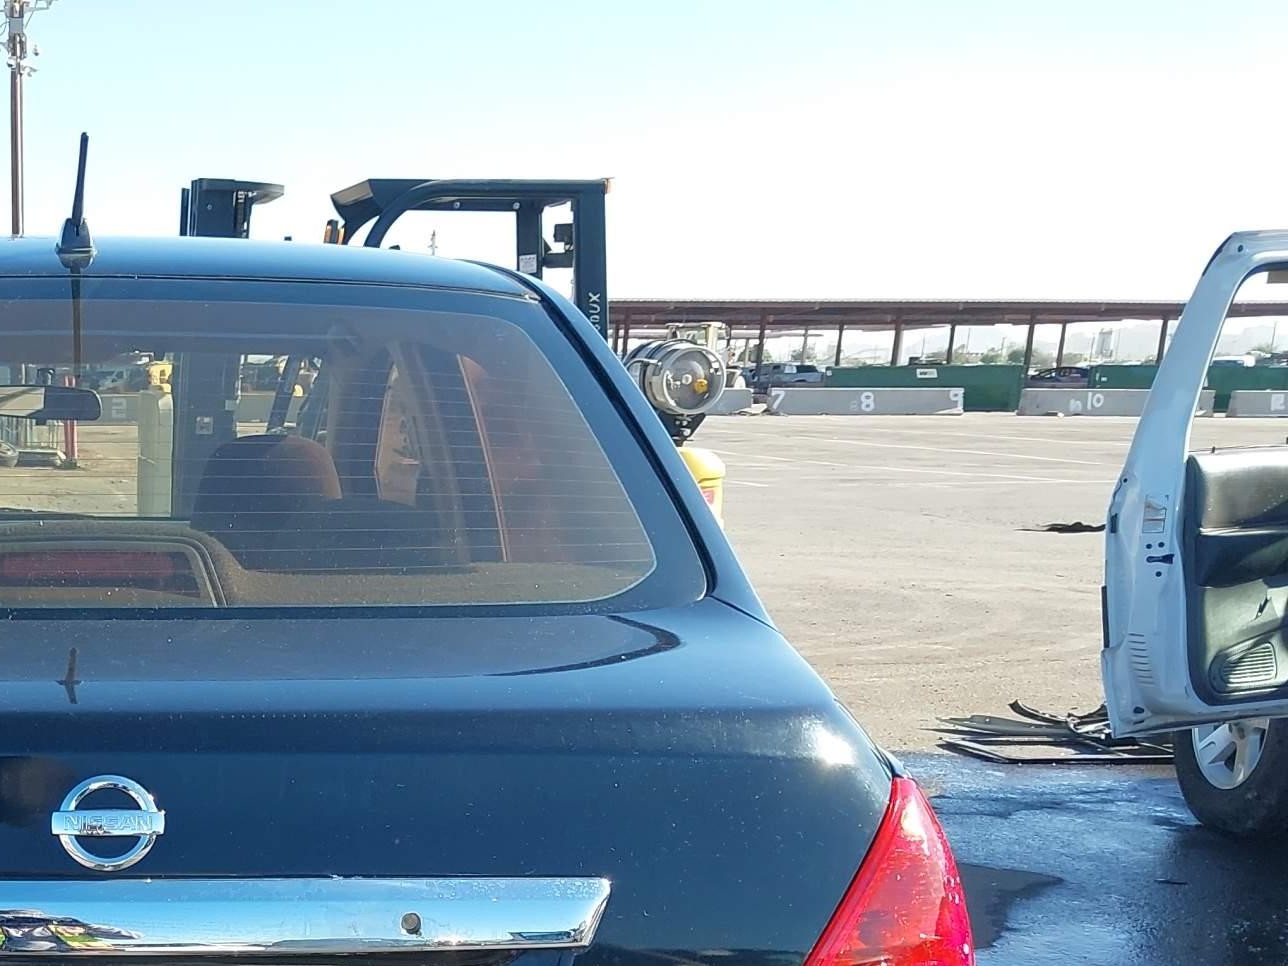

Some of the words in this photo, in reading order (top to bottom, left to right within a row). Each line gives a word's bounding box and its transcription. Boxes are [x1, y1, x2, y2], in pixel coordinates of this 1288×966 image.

[771, 391, 786, 410] 7
[861, 391, 875, 412] 8
[949, 390, 964, 409] 9
[1087, 391, 1105, 411] 10
[63, 814, 153, 832] NISSAN
